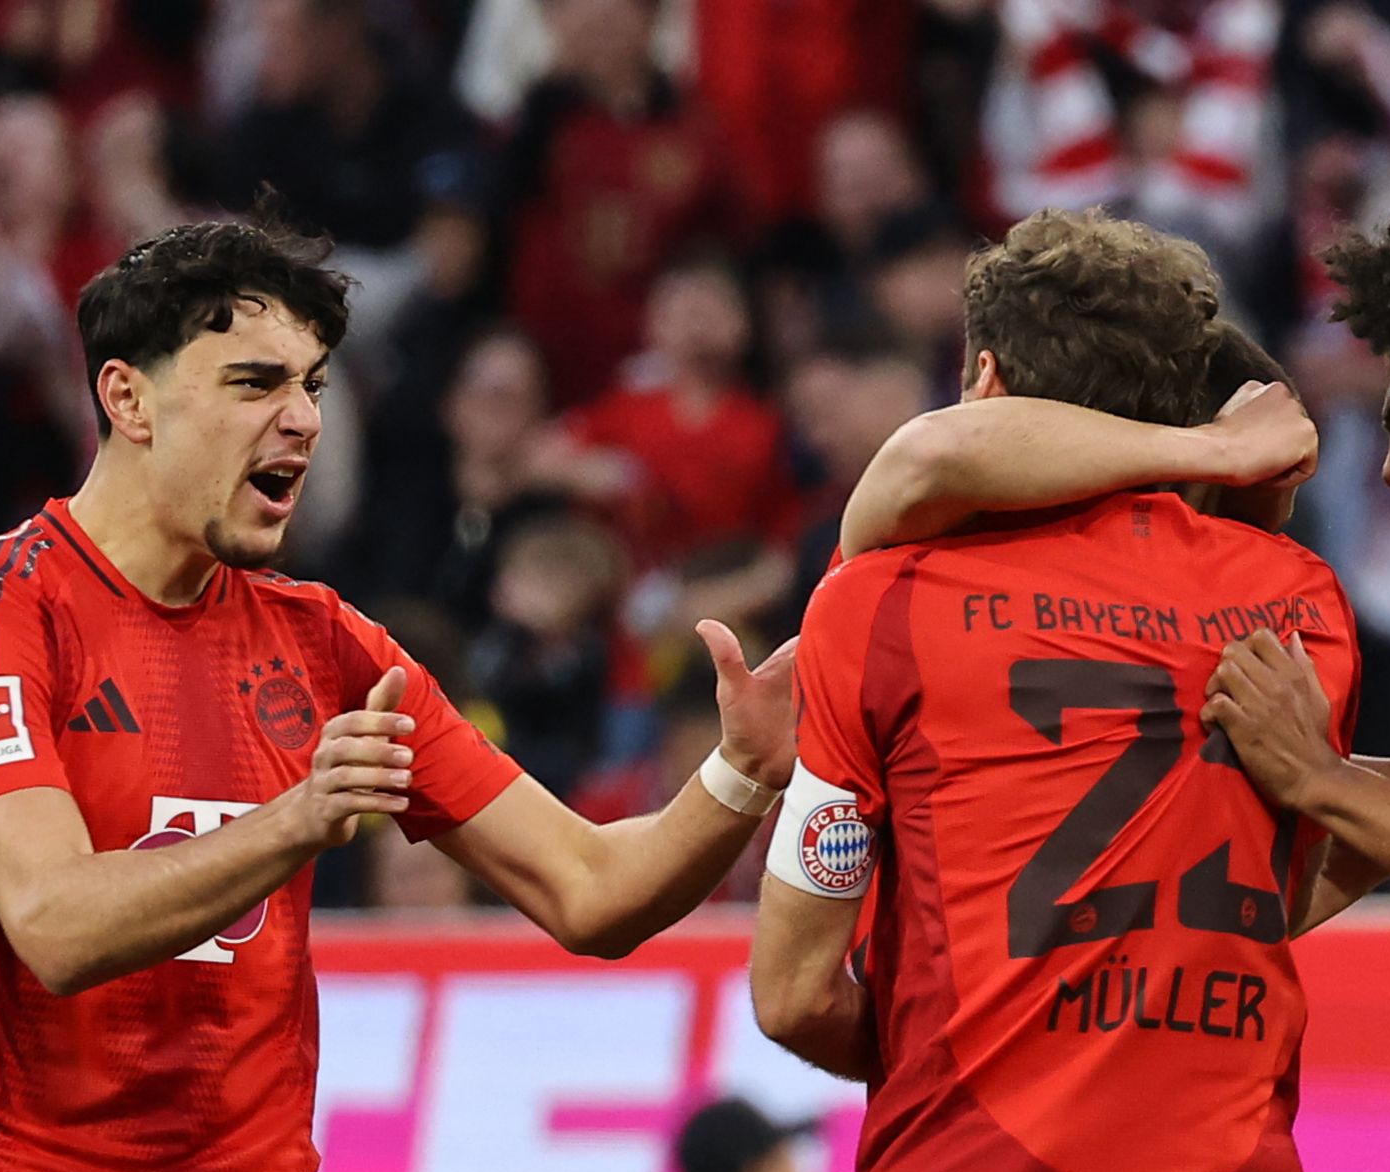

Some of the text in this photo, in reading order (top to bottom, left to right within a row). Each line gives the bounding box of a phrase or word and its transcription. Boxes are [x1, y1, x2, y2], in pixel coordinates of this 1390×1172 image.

[963, 593, 1012, 631] FC
[1032, 592, 1183, 642] BAYERN
[809, 811, 830, 832] FC
[1046, 953, 1267, 1042] MÜLLER
